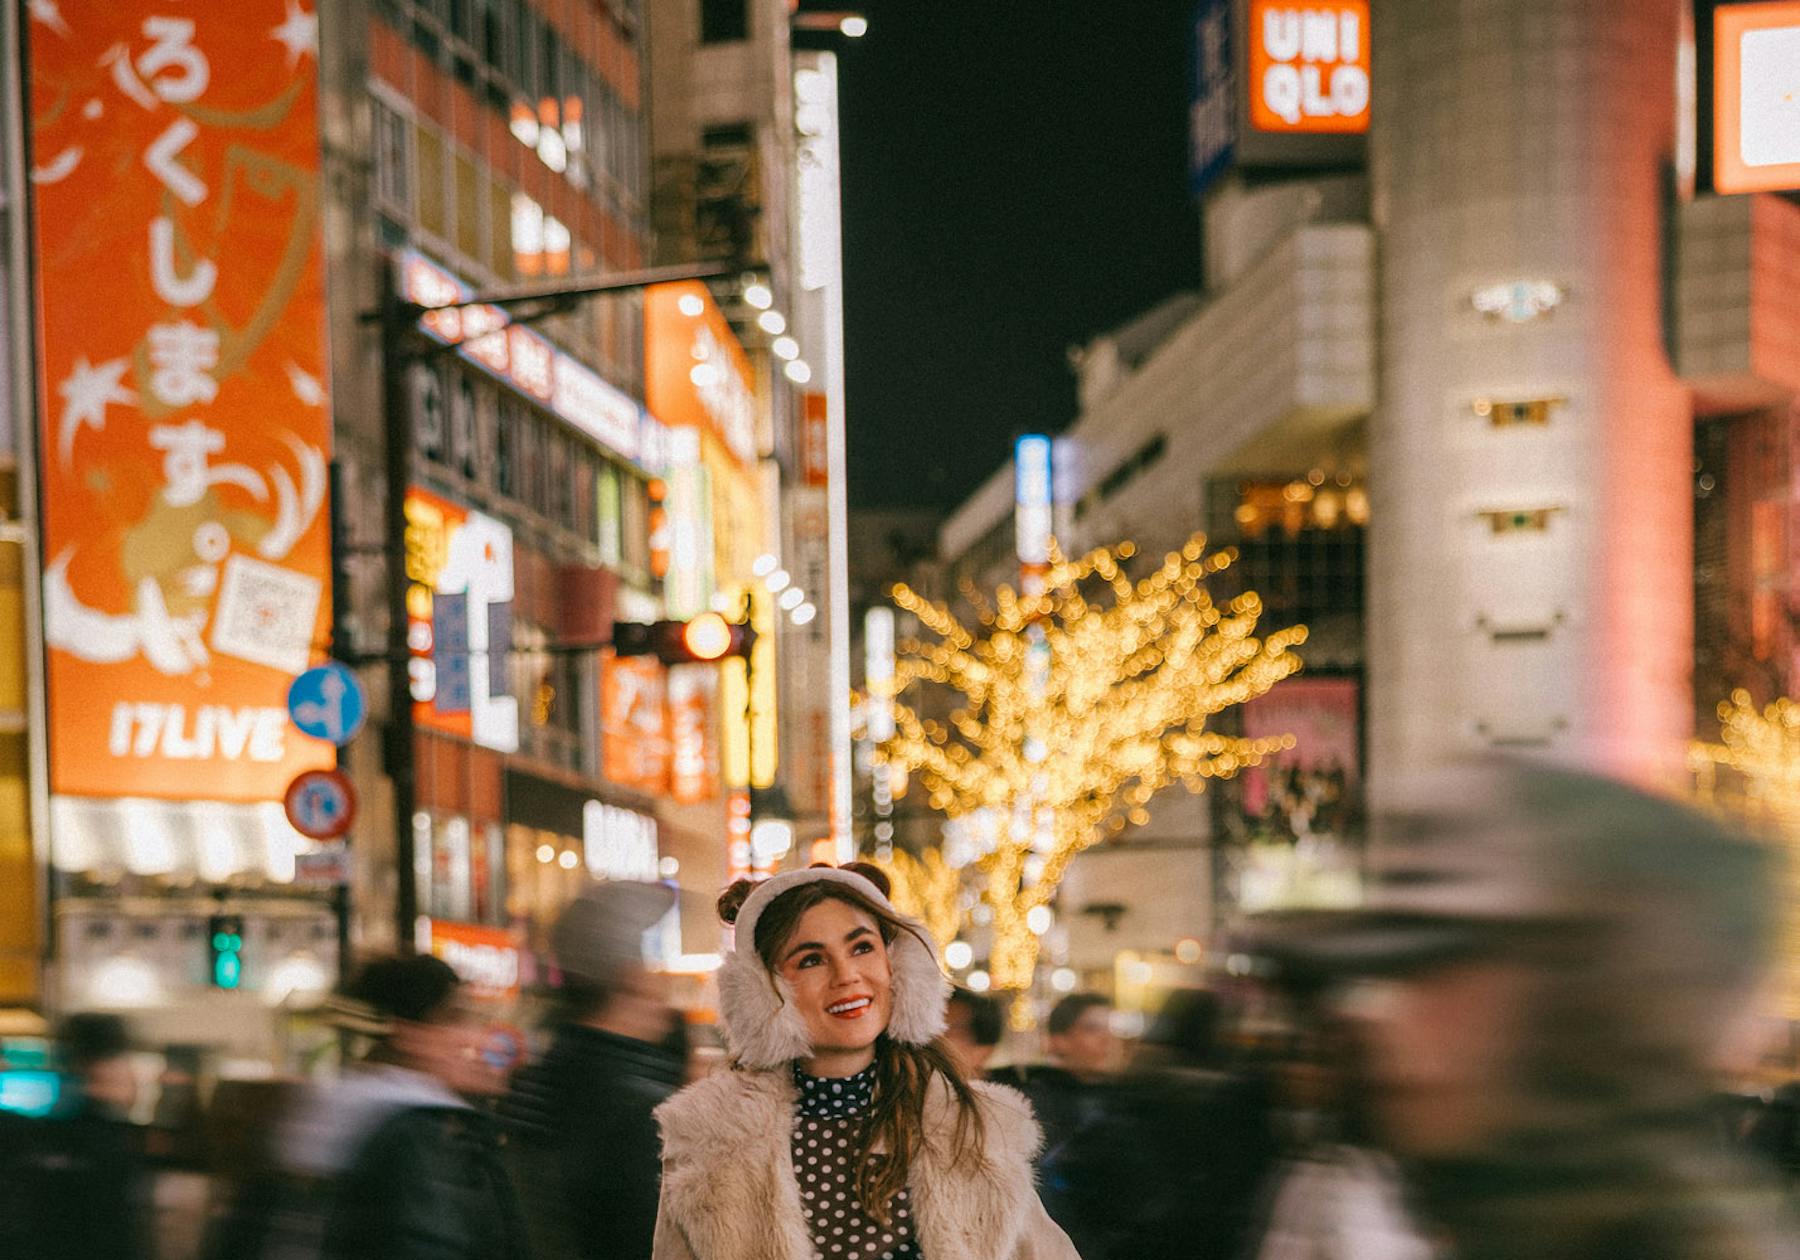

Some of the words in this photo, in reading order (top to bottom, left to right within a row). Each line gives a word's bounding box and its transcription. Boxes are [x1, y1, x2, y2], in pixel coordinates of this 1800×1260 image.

[1263, 8, 1360, 63] UNI
[1263, 64, 1370, 125] QLO
[110, 703, 286, 761] 17LIVE
